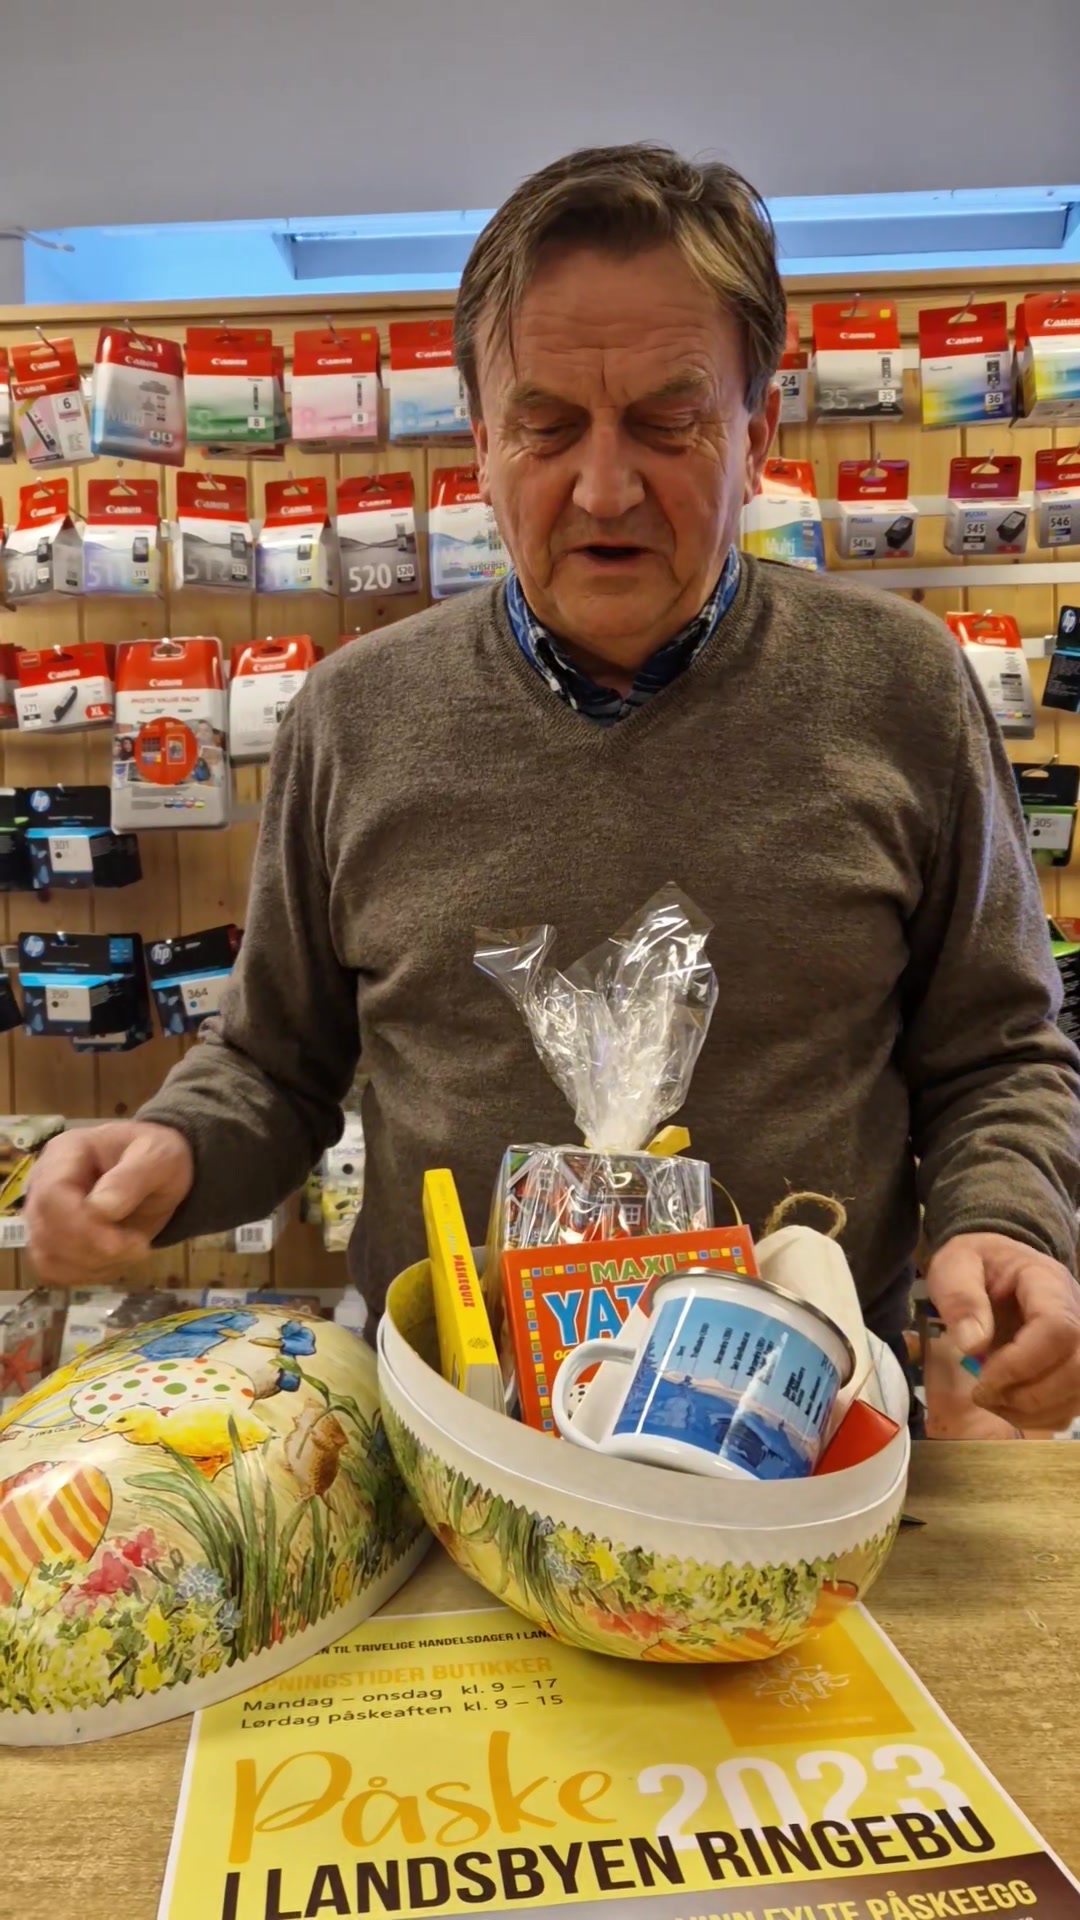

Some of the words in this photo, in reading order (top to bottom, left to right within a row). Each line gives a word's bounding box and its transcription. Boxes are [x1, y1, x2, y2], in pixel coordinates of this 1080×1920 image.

[1043, 318, 1080, 328] Cano
[840, 332, 876, 340] Canon
[946, 336, 983, 346] Canon
[415, 350, 452, 359] Canon
[30, 360, 61, 372] Canon
[125, 355, 159, 369] Canon
[211, 358, 248, 366] Canon
[317, 358, 353, 366] Canon
[781, 376, 796, 387] 24
[17, 384, 48, 396] Canon
[822, 389, 849, 410] 35
[881, 391, 893, 401] 35
[988, 394, 1001, 404] 36
[63, 397, 72, 409] 6
[253, 418, 260, 428] 8
[456, 493, 481, 502] Can
[194, 499, 230, 510] Canon
[358, 499, 393, 508] Canon
[30, 506, 57, 518] Canon
[106, 505, 142, 515] Canon
[280, 505, 313, 516] Canon
[1050, 516, 1070, 528] 546
[966, 524, 985, 534] 545
[397, 564, 414, 575] 520
[348, 564, 392, 593] 520
[253, 663, 287, 672] Canon
[48, 669, 80, 680] Canon
[149, 679, 183, 687] Canon
[90, 706, 105, 717] XL
[32, 791, 50, 812] hp
[1033, 818, 1052, 828] 305
[54, 840, 70, 851] 301
[25, 936, 44, 957] hp
[152, 945, 172, 965] hp
[187, 988, 209, 1000] 364
[590, 1253, 676, 1285] MAXI
[541, 1283, 648, 1347] YAT
[333, 1645, 351, 1655] TIL
[354, 1641, 415, 1653] TRIVELIGE
[418, 1632, 514, 1649] HANDELSDAGER
[254, 1666, 425, 1694] PNINGSTIDER
[432, 1656, 553, 1681] BUTIKKER
[243, 1697, 334, 1711] Mandag
[362, 1688, 443, 1703] onsdag
[461, 1681, 485, 1696] kl.
[491, 1681, 505, 1693] 9
[532, 1678, 558, 1689] 17
[240, 1711, 320, 1729] Lørdag
[328, 1703, 453, 1725] påskeaften
[463, 1699, 486, 1713] kl.
[495, 1697, 508, 1710] 9
[536, 1694, 563, 1706] 15
[228, 1730, 619, 1864] Påske
[637, 1743, 970, 1851] 2023
[221, 1871, 241, 1920] I
[265, 1835, 686, 1920] LANDSBYEN
[694, 1805, 996, 1881] RINGEBU
[864, 1880, 1038, 1920] PÅSKEEGG
